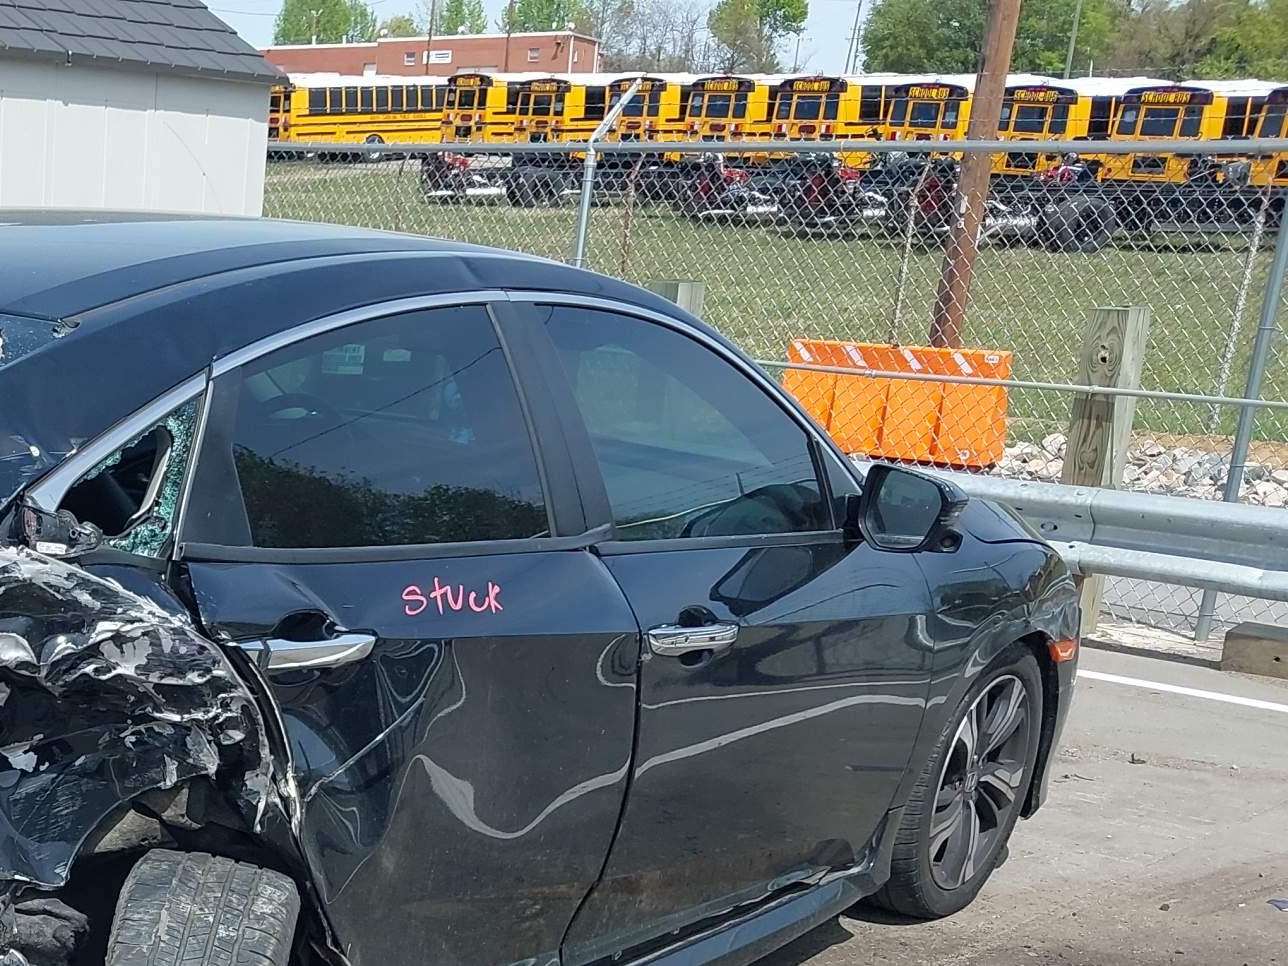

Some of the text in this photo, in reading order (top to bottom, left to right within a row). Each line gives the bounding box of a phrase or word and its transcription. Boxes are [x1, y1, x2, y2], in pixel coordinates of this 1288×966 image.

[909, 87, 949, 98] SCHOOL BUS
[1013, 90, 1059, 103] SCHOOL BUS
[1141, 91, 1192, 103] SCHOOL BUS
